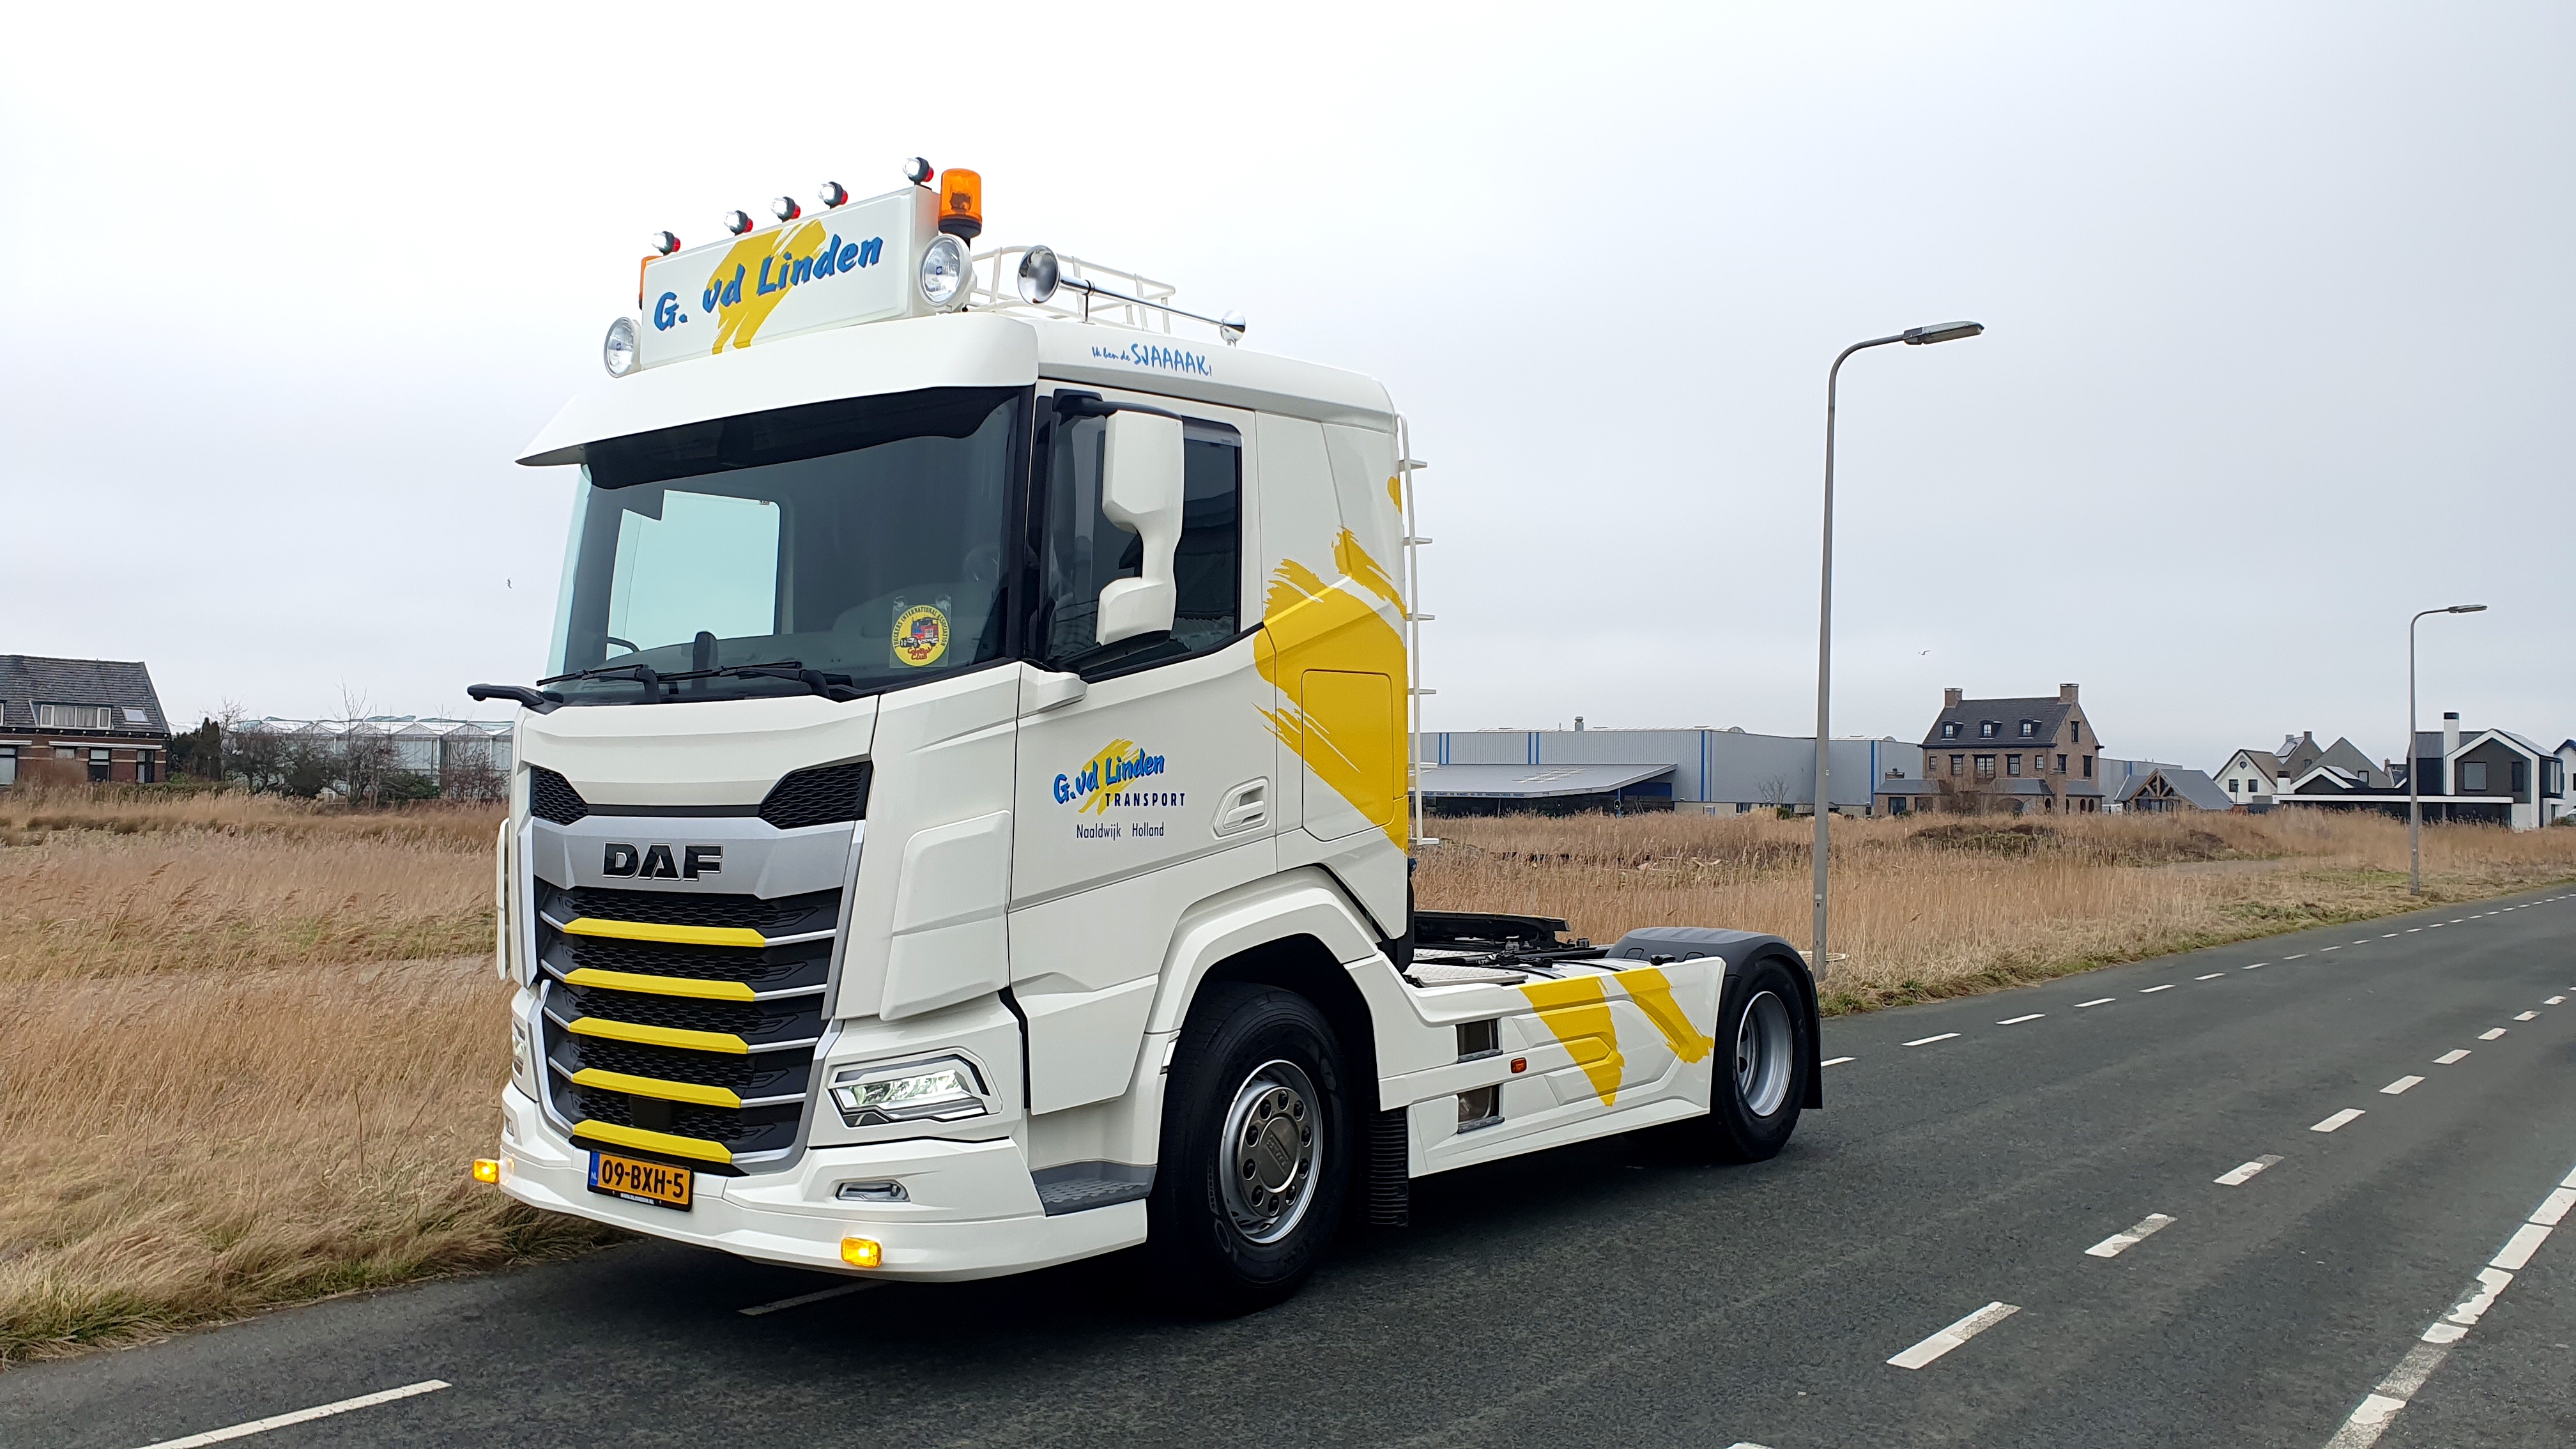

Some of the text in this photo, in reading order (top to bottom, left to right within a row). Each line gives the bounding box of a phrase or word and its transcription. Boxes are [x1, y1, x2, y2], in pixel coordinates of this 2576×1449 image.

[654, 233, 883, 331] G. vd Linden
[1103, 347, 1119, 360] ben
[1120, 349, 1130, 361] de
[893, 606, 948, 648] TRUCKERS INTERNATIONAL ASSOCIATION
[1105, 747, 1165, 785] Linden
[1105, 793, 1185, 807] TRANSPORT
[1077, 822, 1164, 841] Naaldwijk Holland
[602, 841, 723, 881] DAF
[591, 1172, 597, 1181] NL
[602, 1160, 684, 1199] 09-BXH-5
